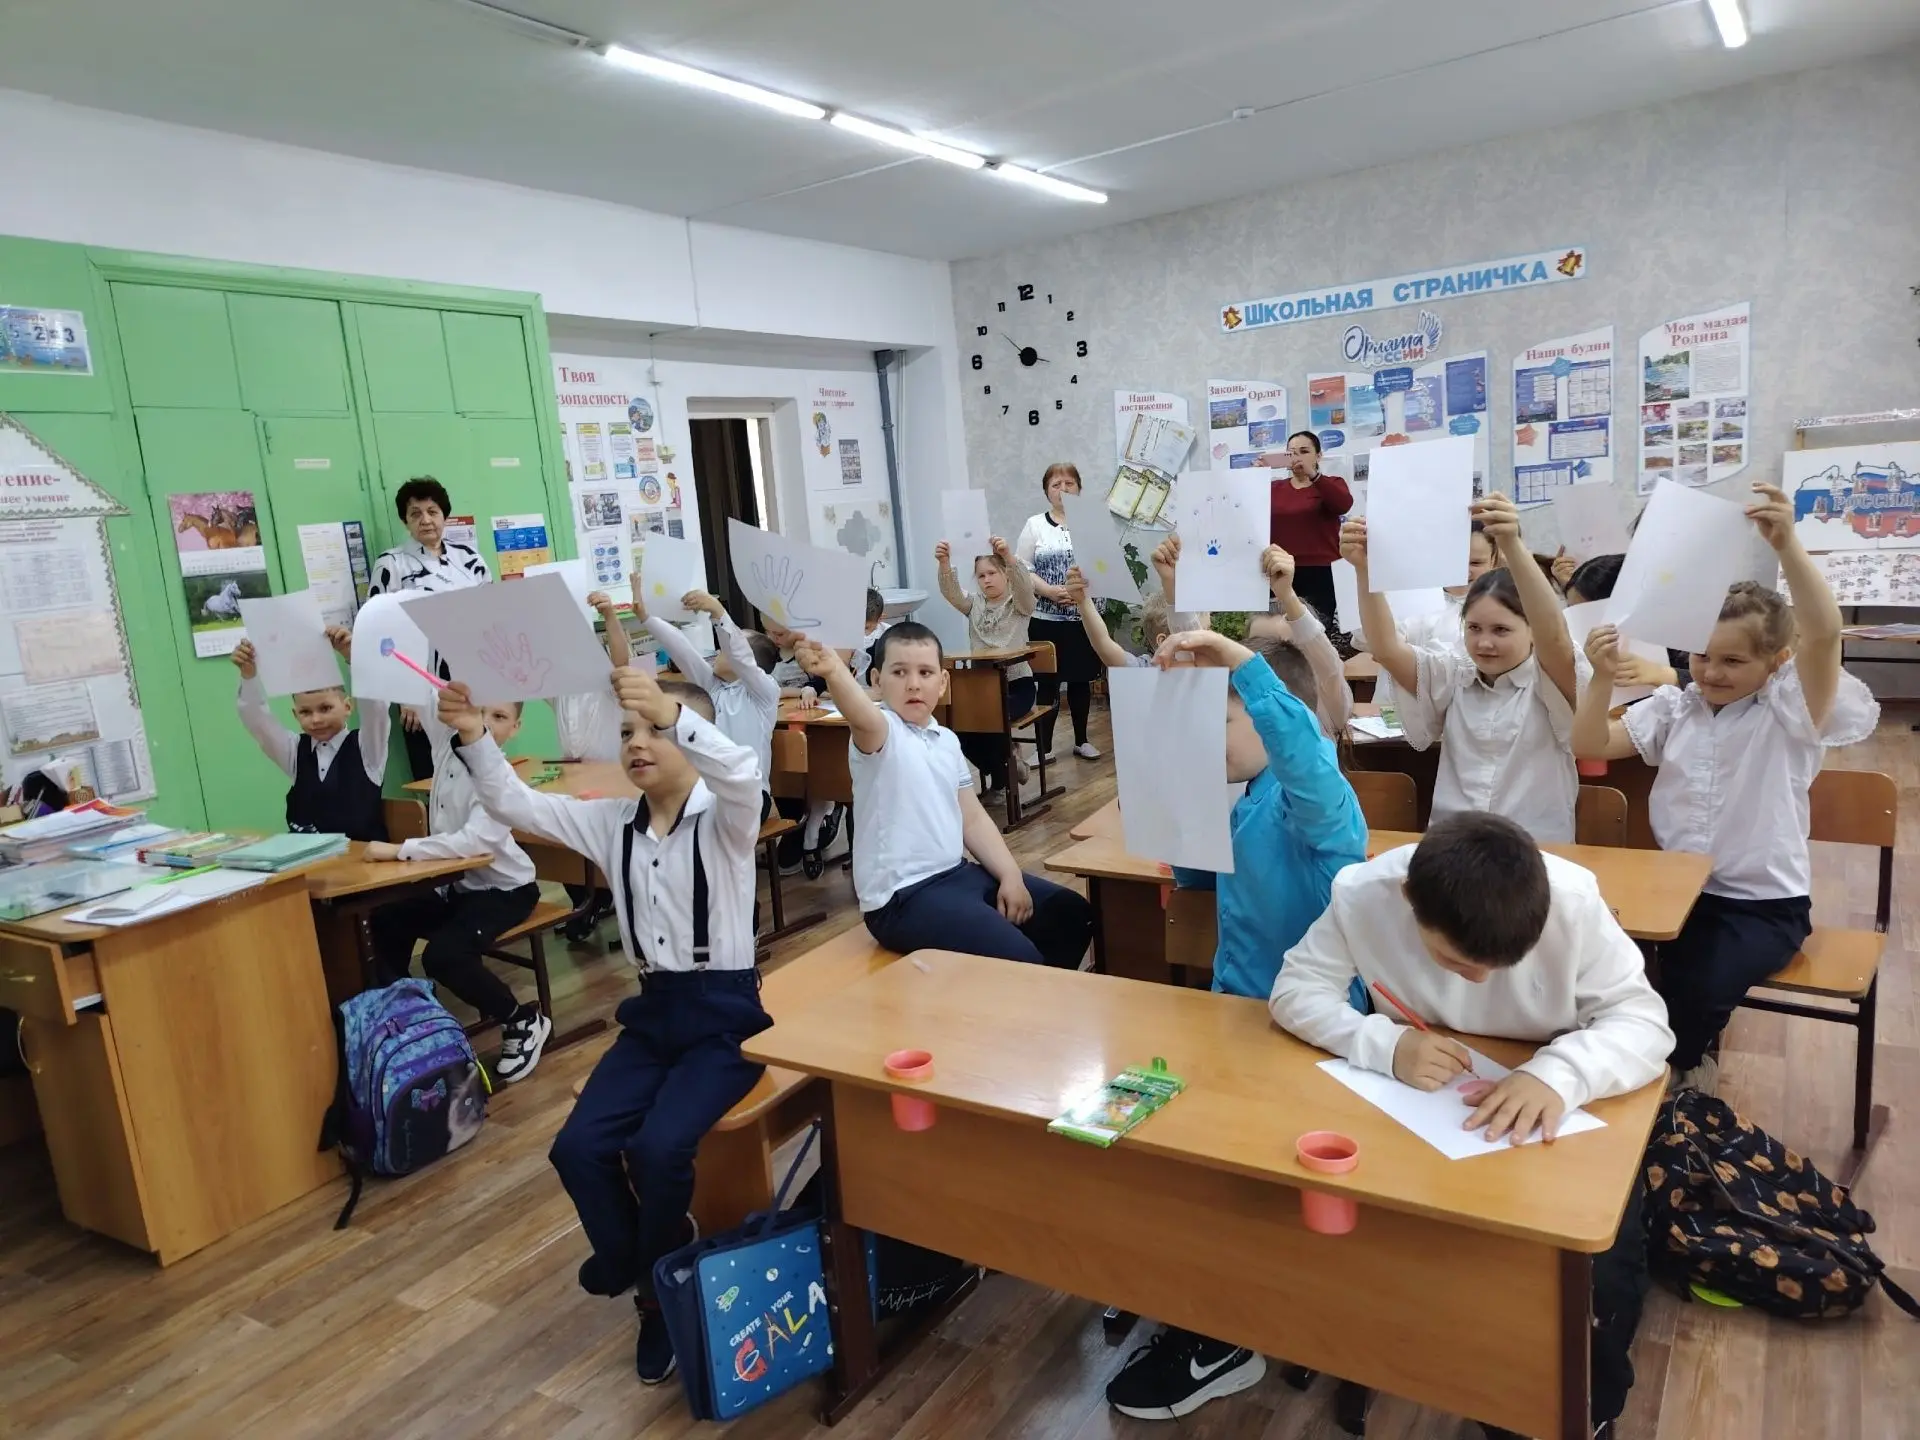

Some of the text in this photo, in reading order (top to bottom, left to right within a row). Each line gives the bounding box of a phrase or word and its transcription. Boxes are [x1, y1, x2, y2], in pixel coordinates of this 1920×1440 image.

[1017, 284, 1034, 301] 12
[1244, 260, 1548, 326] ШКОЛЬНАЯ СТРАНИЧКА
[1047, 294, 1052, 304] 1
[997, 302, 1006, 312] 11
[1066, 311, 1074, 321] 2
[1664, 315, 1748, 334] Моя малая
[977, 326, 988, 336] 10
[1344, 325, 1424, 360] Орлята
[1671, 330, 1728, 346] Родина
[1076, 341, 1088, 357] 3
[1526, 341, 1610, 361] Наши будни
[559, 367, 596, 383] Твоя
[1070, 375, 1078, 384] 4
[984, 385, 991, 394] 8
[1248, 389, 1283, 401] Орлят
[556, 394, 630, 406] зопасность
[1129, 394, 1155, 403] Наши
[1001, 405, 1009, 415] 7
[1055, 400, 1063, 410] 5
[1119, 402, 1173, 413] достижения
[1028, 410, 1040, 425] 6
[0, 474, 60, 487] ение-
[1833, 492, 1914, 511] РОССИЯ
[729, 1289, 795, 1347] CREATE YOUR
